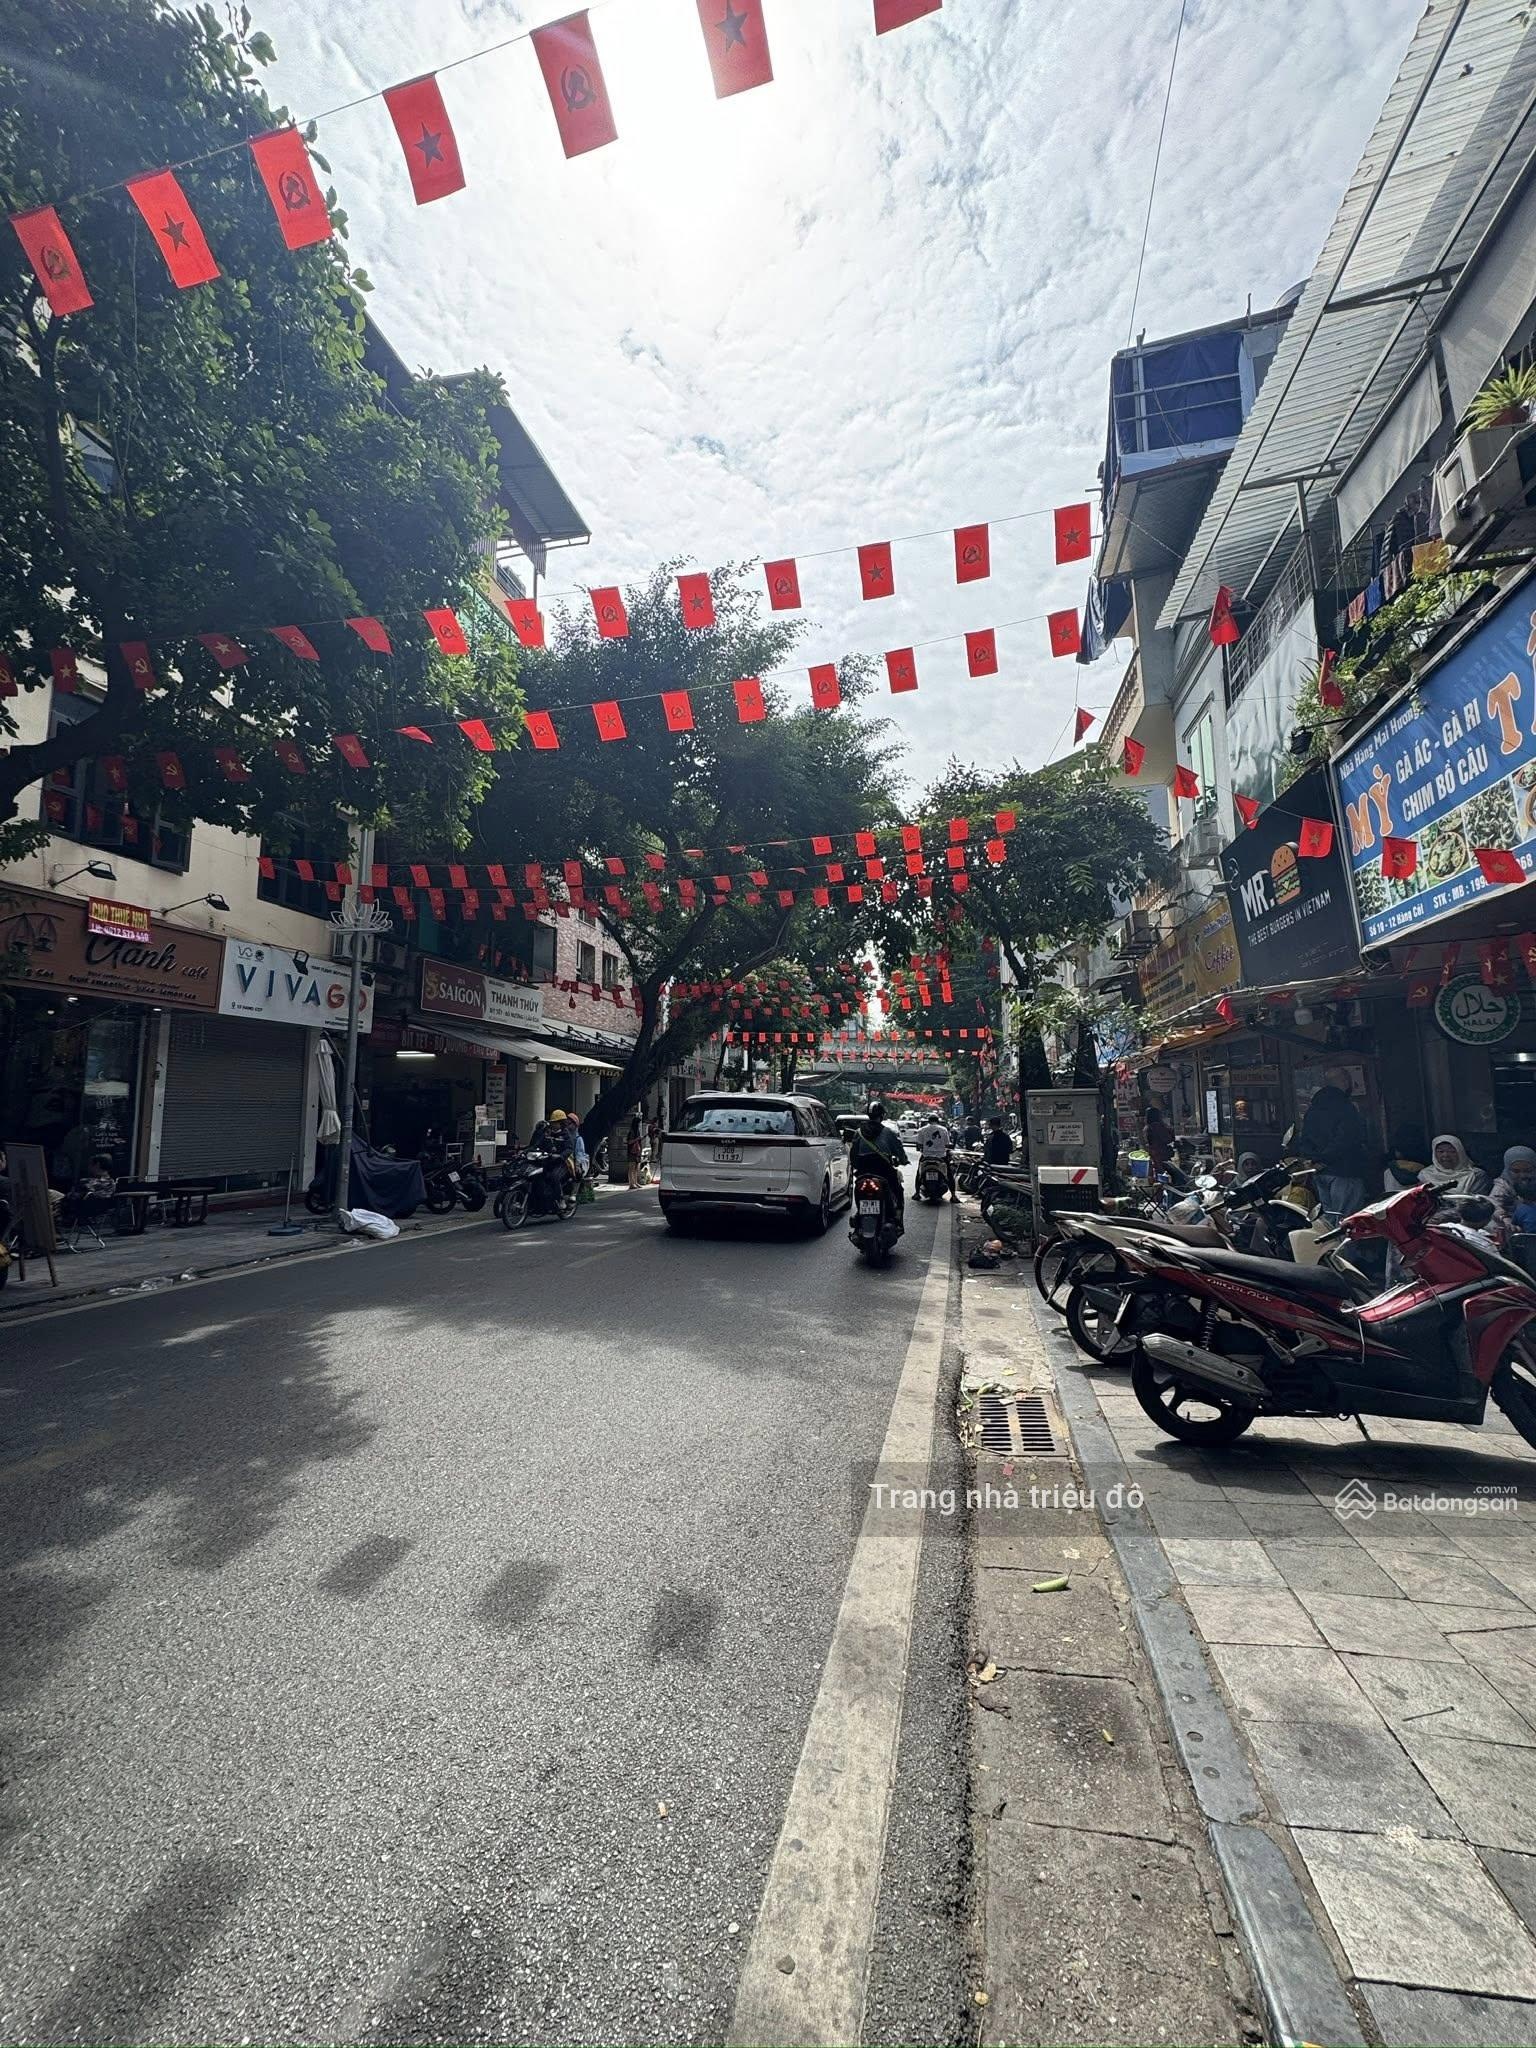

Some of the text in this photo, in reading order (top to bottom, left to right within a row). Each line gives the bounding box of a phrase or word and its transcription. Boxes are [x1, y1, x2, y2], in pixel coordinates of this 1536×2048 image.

[1395, 750, 1411, 785] GÀ
[1414, 738, 1432, 772] ÁC
[1441, 711, 1463, 749] GÀ
[1463, 697, 1481, 733] RI
[1354, 743, 1375, 768] Hàng
[1402, 788, 1434, 823] CHIM
[1456, 743, 1489, 786] CÂU
[1433, 892, 1447, 909] STK
[1452, 885, 1465, 901] MB
[92, 902, 109, 921] CHO
[1256, 926, 1269, 944] BEST
[1269, 911, 1295, 937] BURGERS
[1302, 889, 1332, 918] VIETNAM
[1388, 916, 1397, 928] 12
[1204, 943, 1235, 977] Coffee
[439, 982, 481, 1008] SAIGON
[491, 991, 519, 1009] THANH
[1463, 1019, 1499, 1027] HALAL
